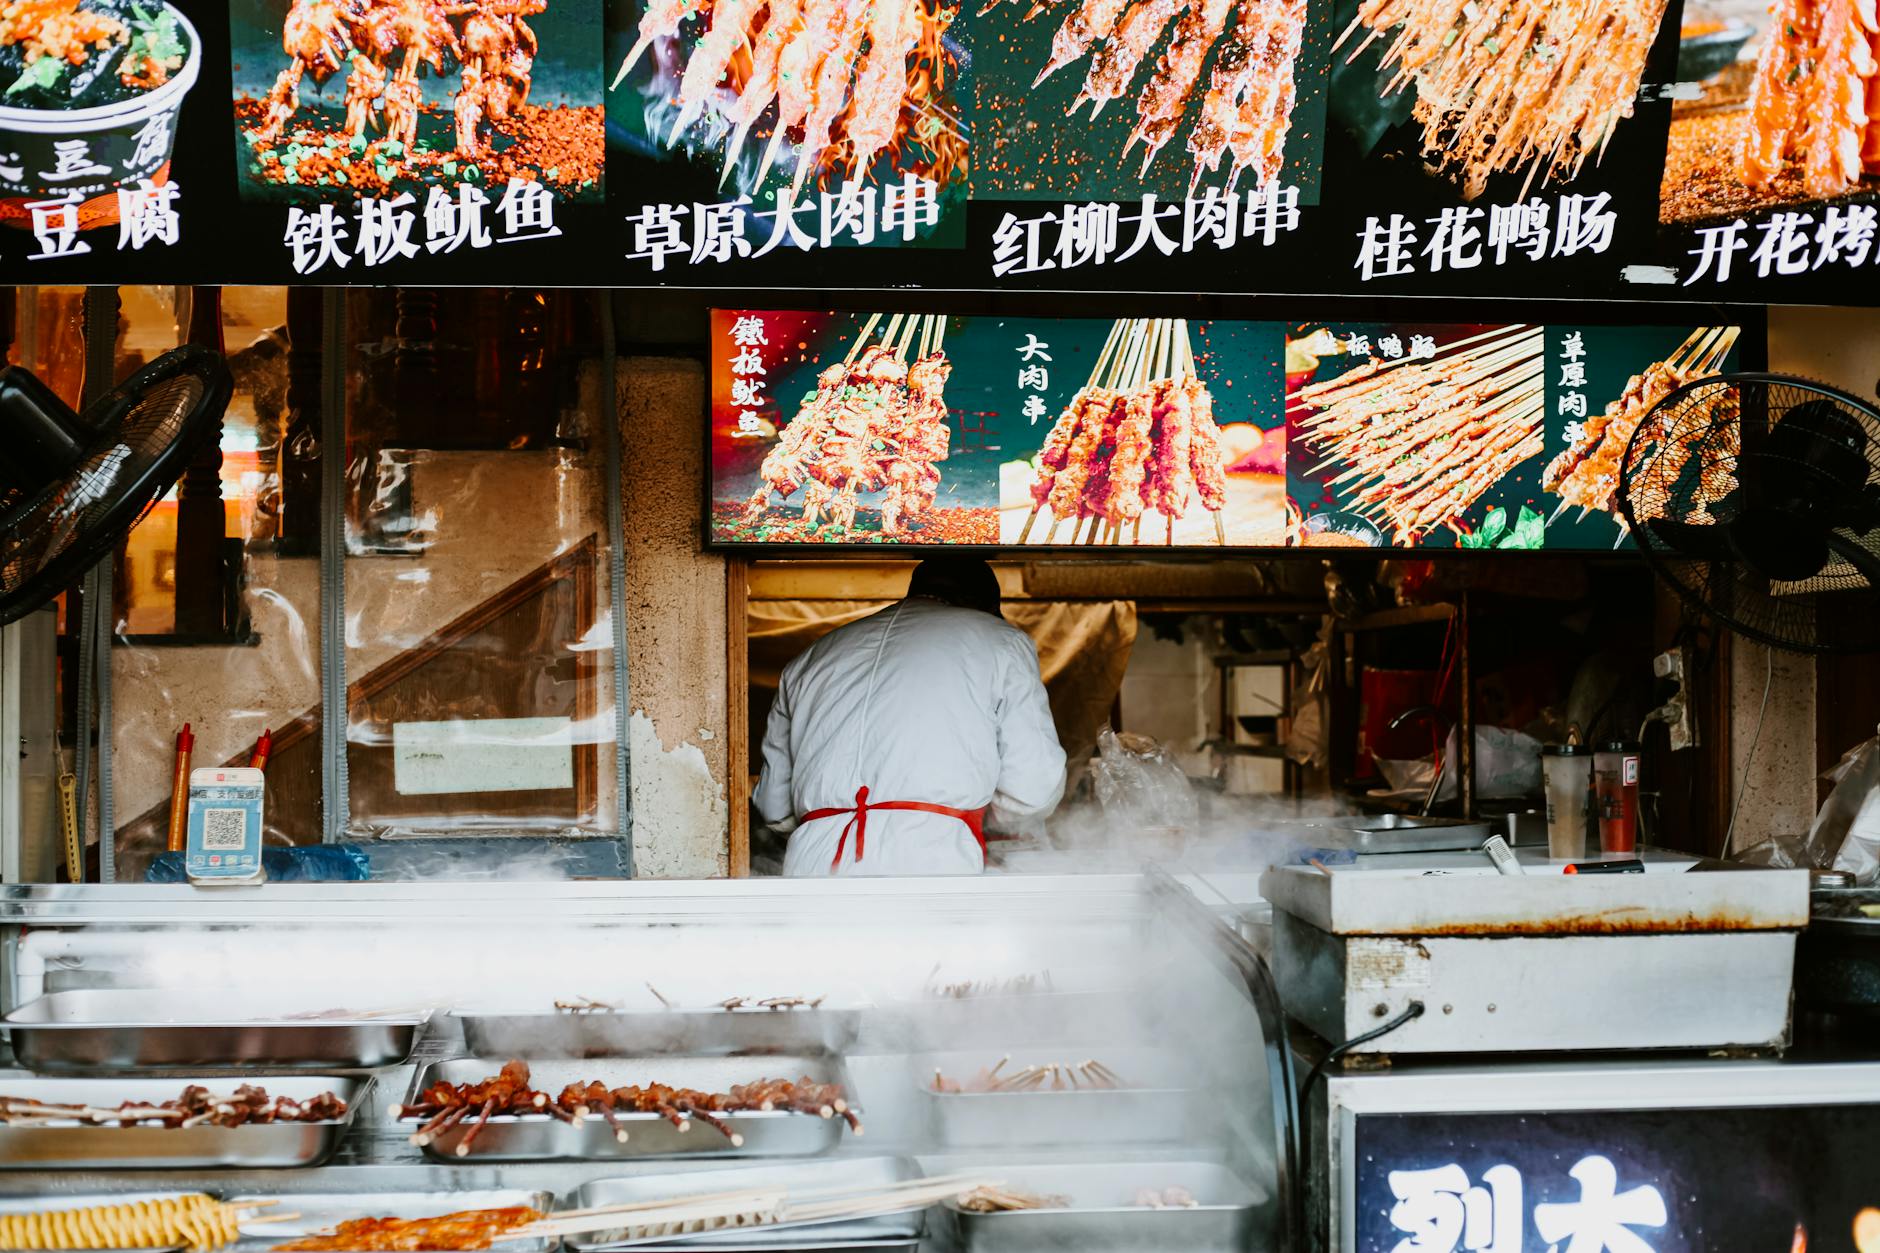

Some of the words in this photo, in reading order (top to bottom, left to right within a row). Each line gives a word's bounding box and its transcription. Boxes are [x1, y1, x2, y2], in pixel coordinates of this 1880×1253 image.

[24, 178, 181, 261] 豆腐
[284, 177, 563, 275] 铁板鱿鱼
[624, 172, 940, 271] 草原大肉串
[991, 179, 1302, 278] 红柳大肉串
[1353, 191, 1617, 281] 桂花鸭肠
[1682, 204, 1880, 287] 开花烤
[1015, 333, 1053, 426] 大肉串
[1558, 330, 1588, 452] 草原肉串
